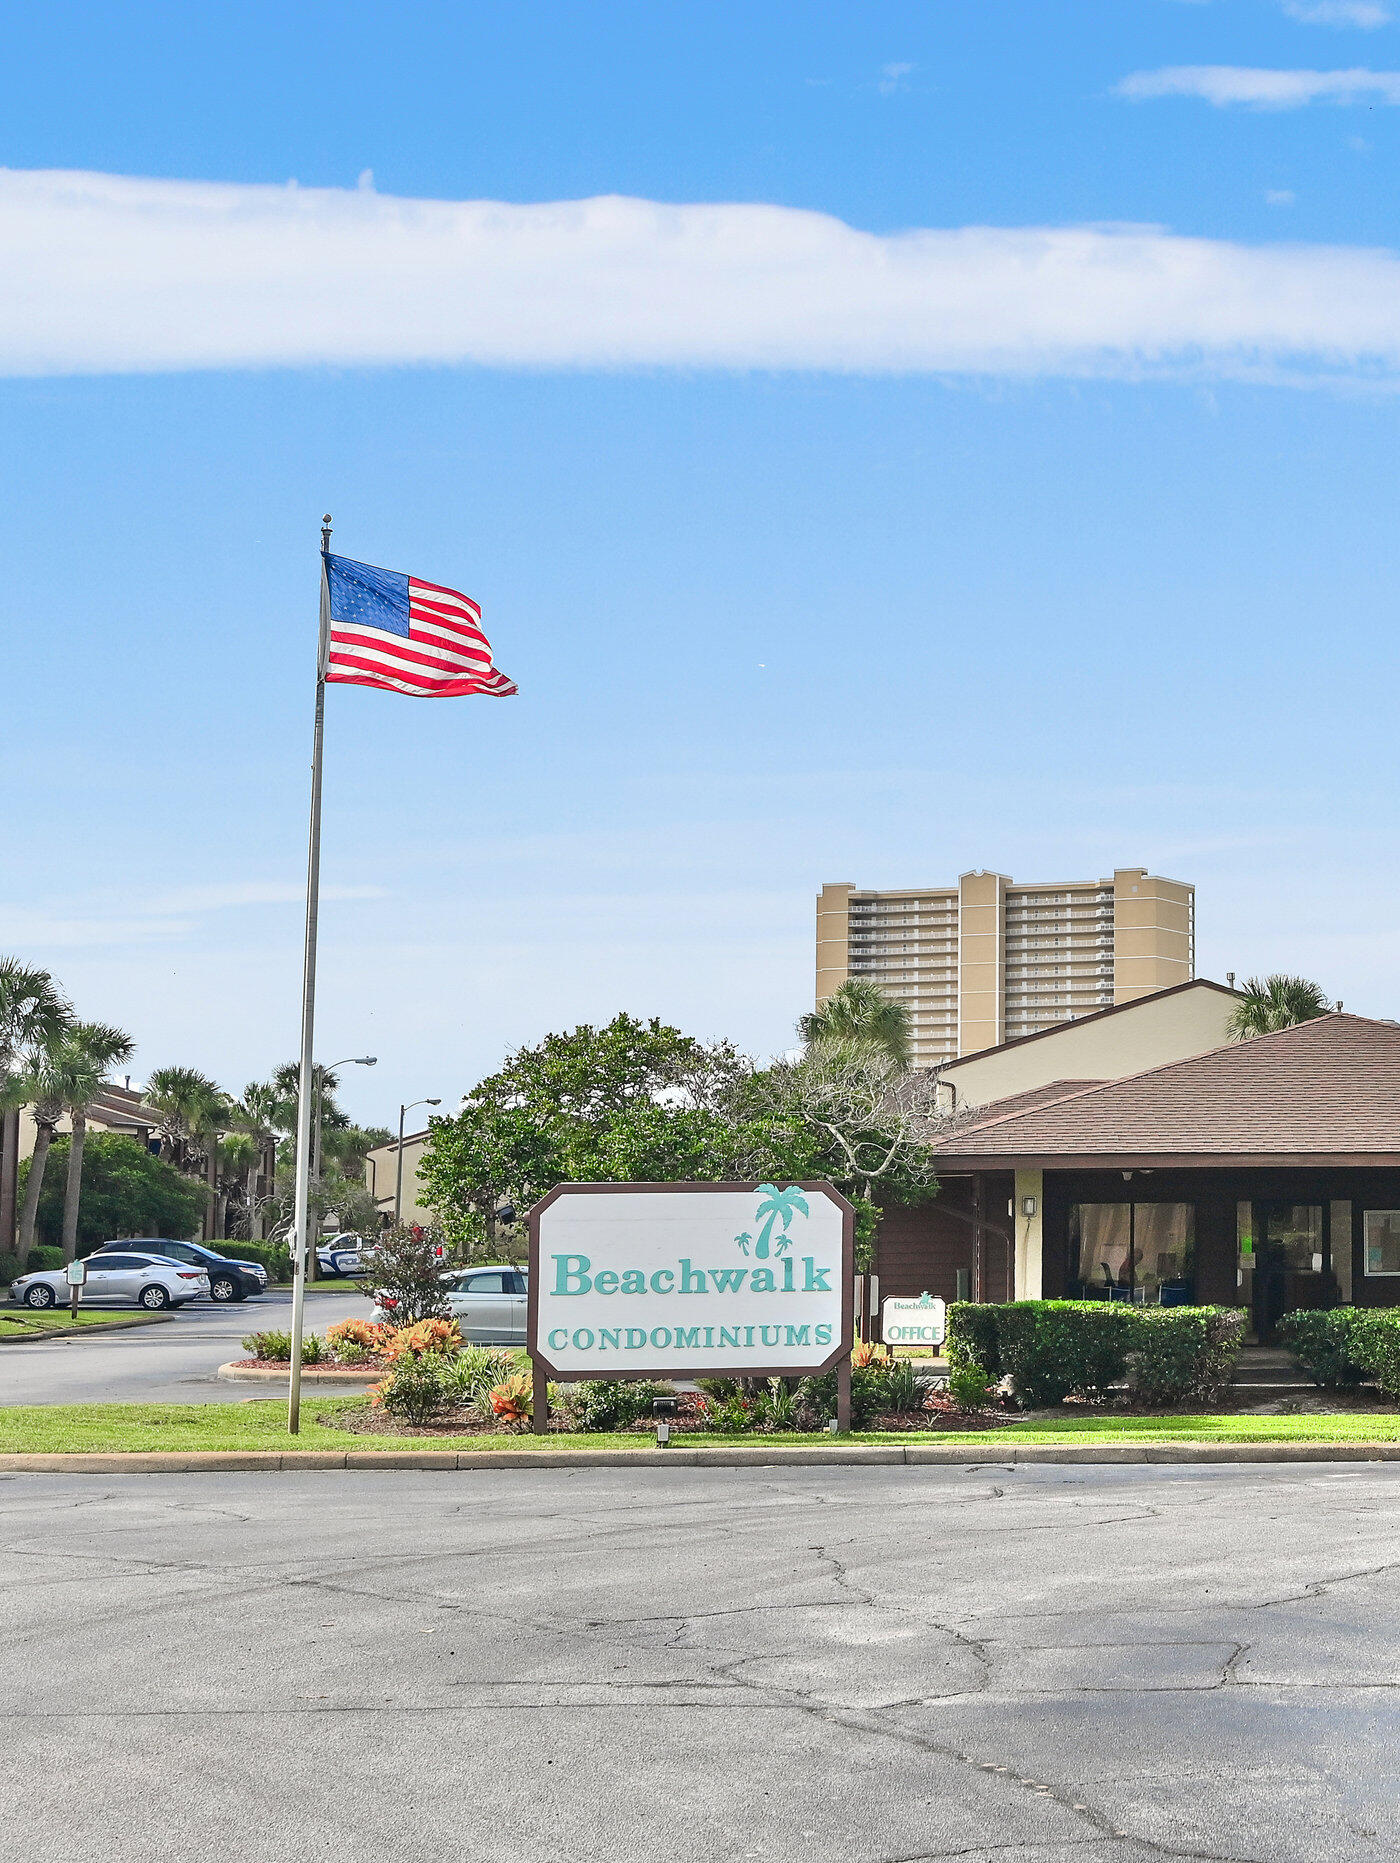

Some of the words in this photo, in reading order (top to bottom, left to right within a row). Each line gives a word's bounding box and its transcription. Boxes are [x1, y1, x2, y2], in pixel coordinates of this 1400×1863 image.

[550, 1254, 832, 1296] Beachwalk
[548, 1323, 832, 1350] CONDOMINIUMS
[888, 1326, 941, 1340] OFFICE
